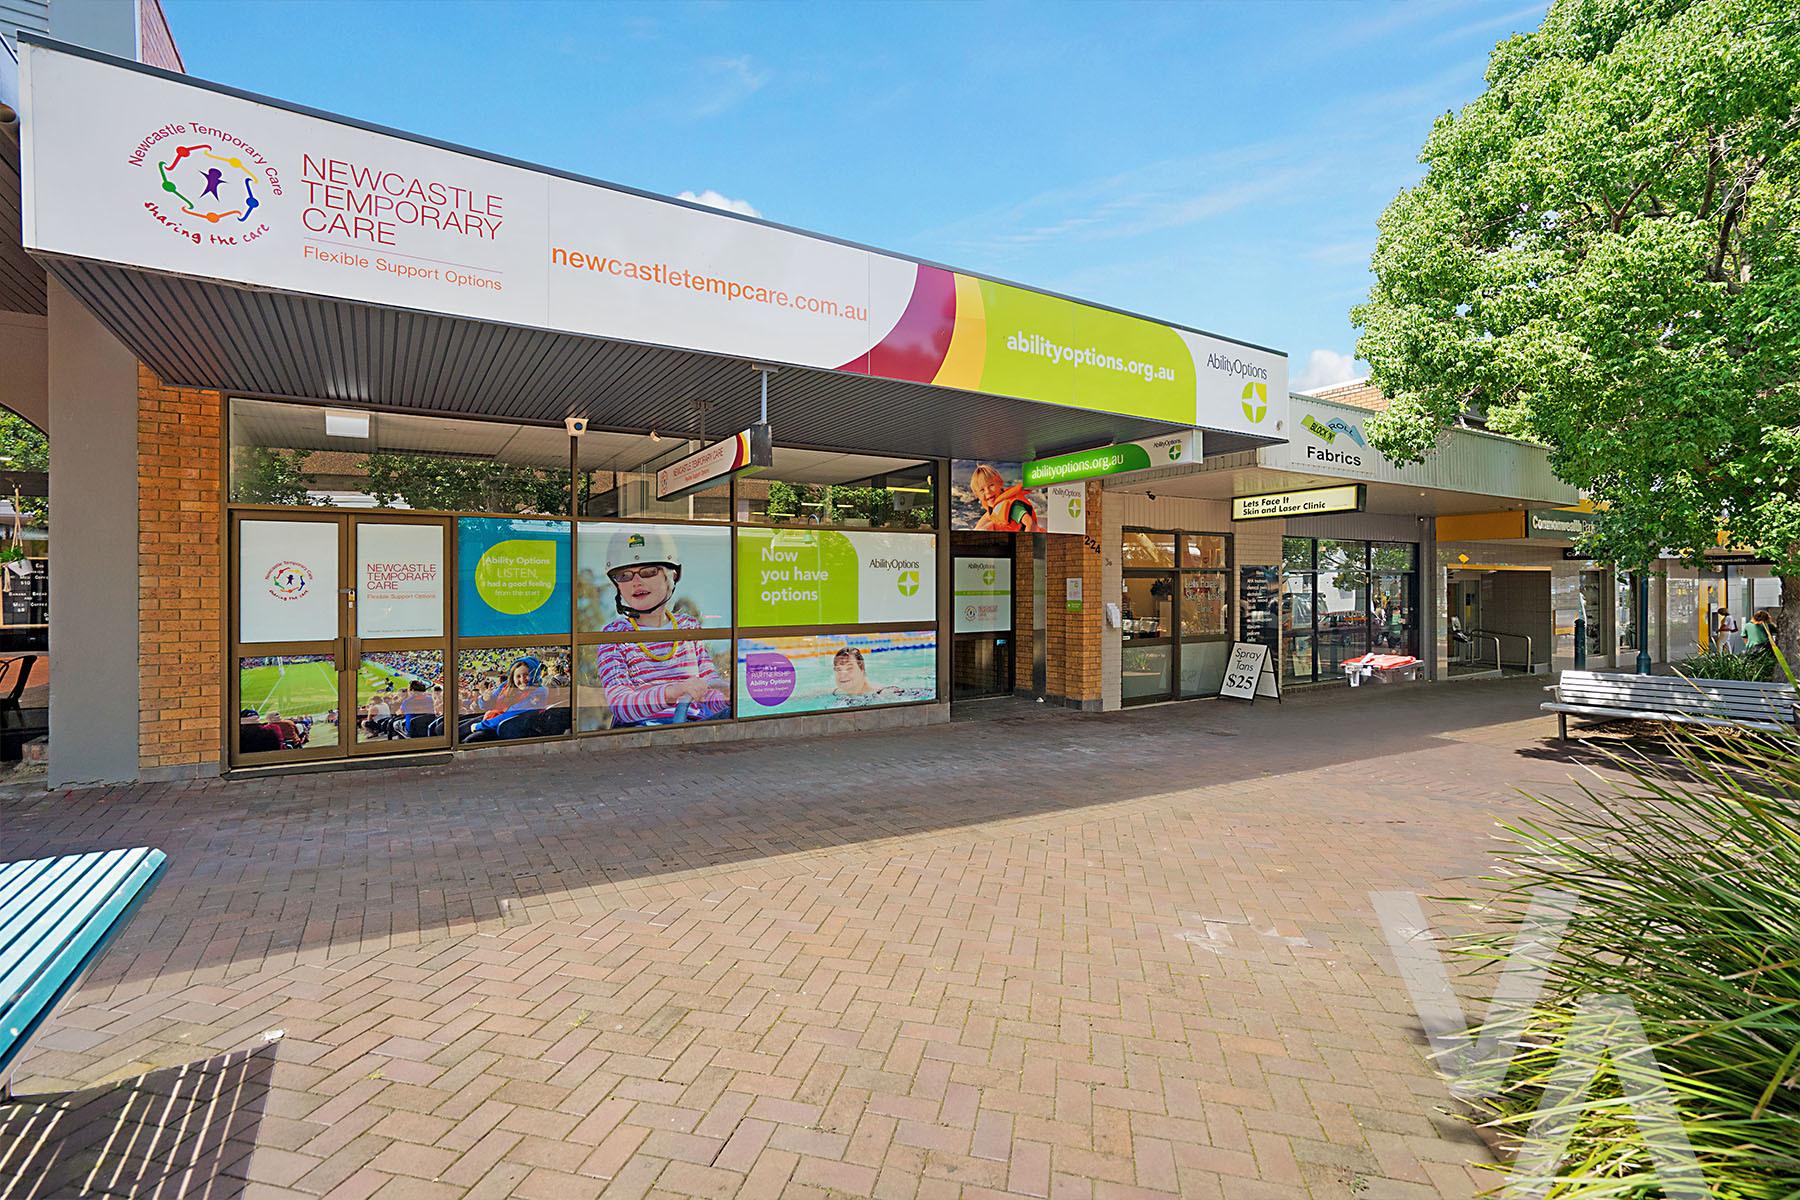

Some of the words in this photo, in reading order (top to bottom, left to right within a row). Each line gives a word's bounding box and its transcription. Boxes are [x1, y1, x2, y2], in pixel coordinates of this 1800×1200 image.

[128, 123, 186, 167] Newcastle
[188, 122, 267, 165] Temporary
[265, 167, 283, 196] Care
[303, 153, 503, 217] NEWCASTLE
[301, 179, 503, 240] TEMPORARY
[144, 201, 202, 244] sharing
[210, 233, 237, 246] the
[243, 223, 270, 243] care
[302, 207, 396, 246] CARE
[303, 245, 369, 269] Flexible
[375, 257, 440, 281] Support
[445, 270, 503, 291] Options
[551, 246, 868, 322] newcastletempcare.com.au
[1006, 330, 1175, 382] abilityoptions.org.au
[1310, 422, 1328, 438] BLOCK
[1328, 422, 1354, 436] ROLL
[1306, 445, 1362, 467] Fabrics
[1031, 453, 1124, 479] abilityoptions.org.au
[1243, 500, 1259, 508] Lets
[1261, 497, 1280, 506] Face
[1282, 496, 1290, 504] It
[1243, 508, 1260, 516] Skin
[1279, 504, 1301, 512] Laser
[1303, 501, 1326, 510] Clinic
[485, 555, 513, 565] Ability
[516, 556, 550, 566] Options
[761, 547, 798, 562] Now
[367, 563, 437, 573] NEWCASTLE
[367, 572, 437, 581] TEMPORARY
[761, 570, 790, 585] you
[793, 566, 829, 581] have
[366, 581, 398, 590] CARE
[761, 587, 819, 605] options
[1235, 647, 1262, 661] Spray
[1236, 659, 1254, 672] Tans
[1226, 673, 1254, 690] $25
